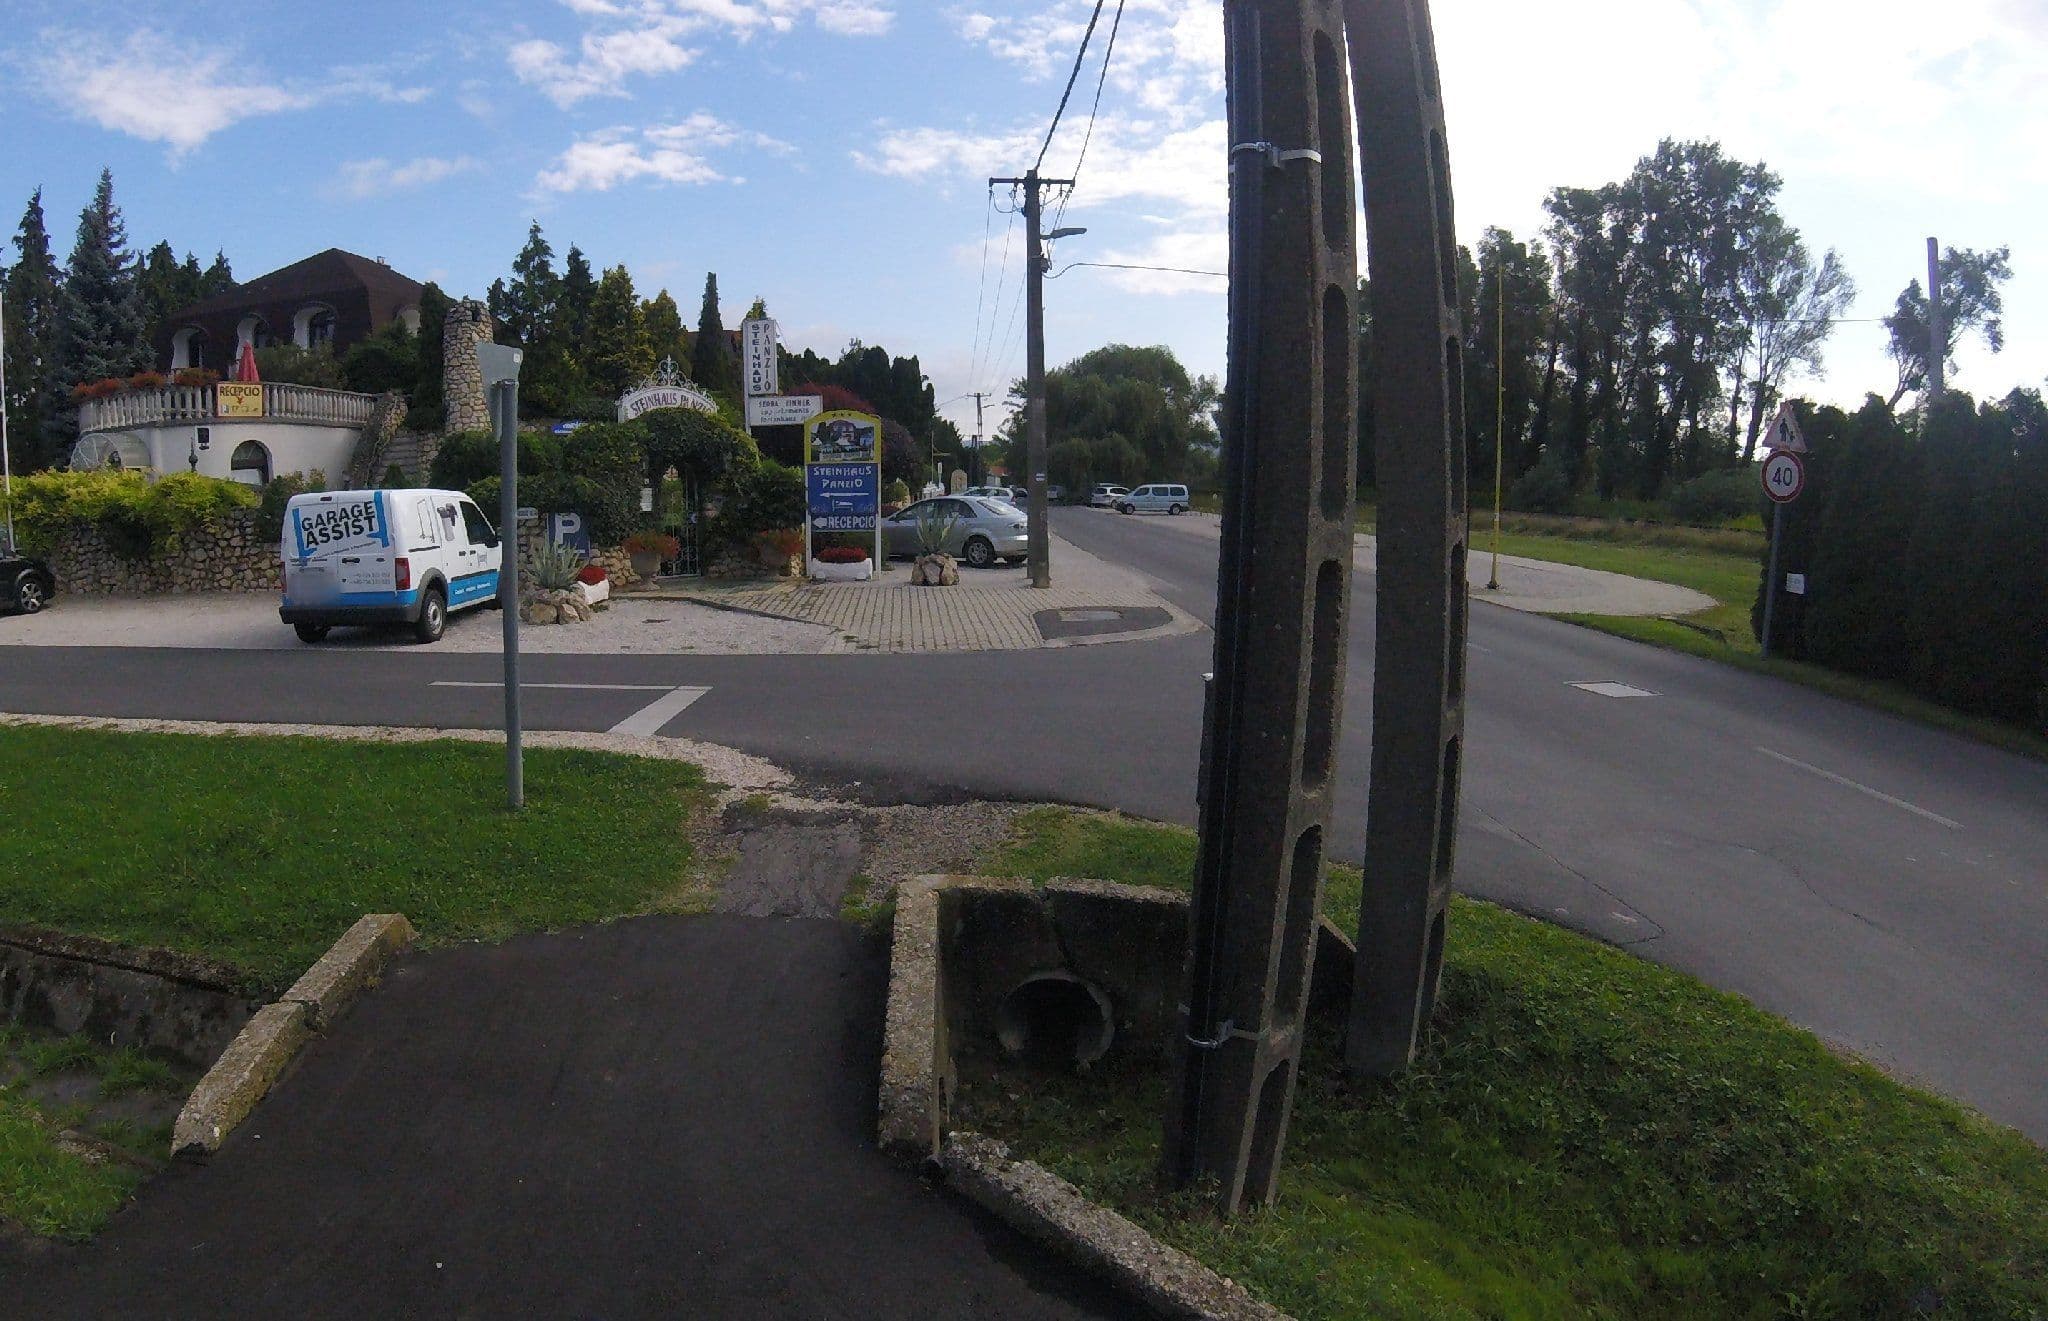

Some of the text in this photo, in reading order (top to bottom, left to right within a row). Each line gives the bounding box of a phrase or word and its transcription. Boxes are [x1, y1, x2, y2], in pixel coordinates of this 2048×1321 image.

[751, 323, 762, 391] STEINHAUS
[630, 392, 678, 416] STEINHAUS
[813, 465, 872, 477] STEINHAUS
[1772, 467, 1793, 487] 40
[301, 501, 375, 532] GARAGE
[306, 515, 376, 548] ASSIST
